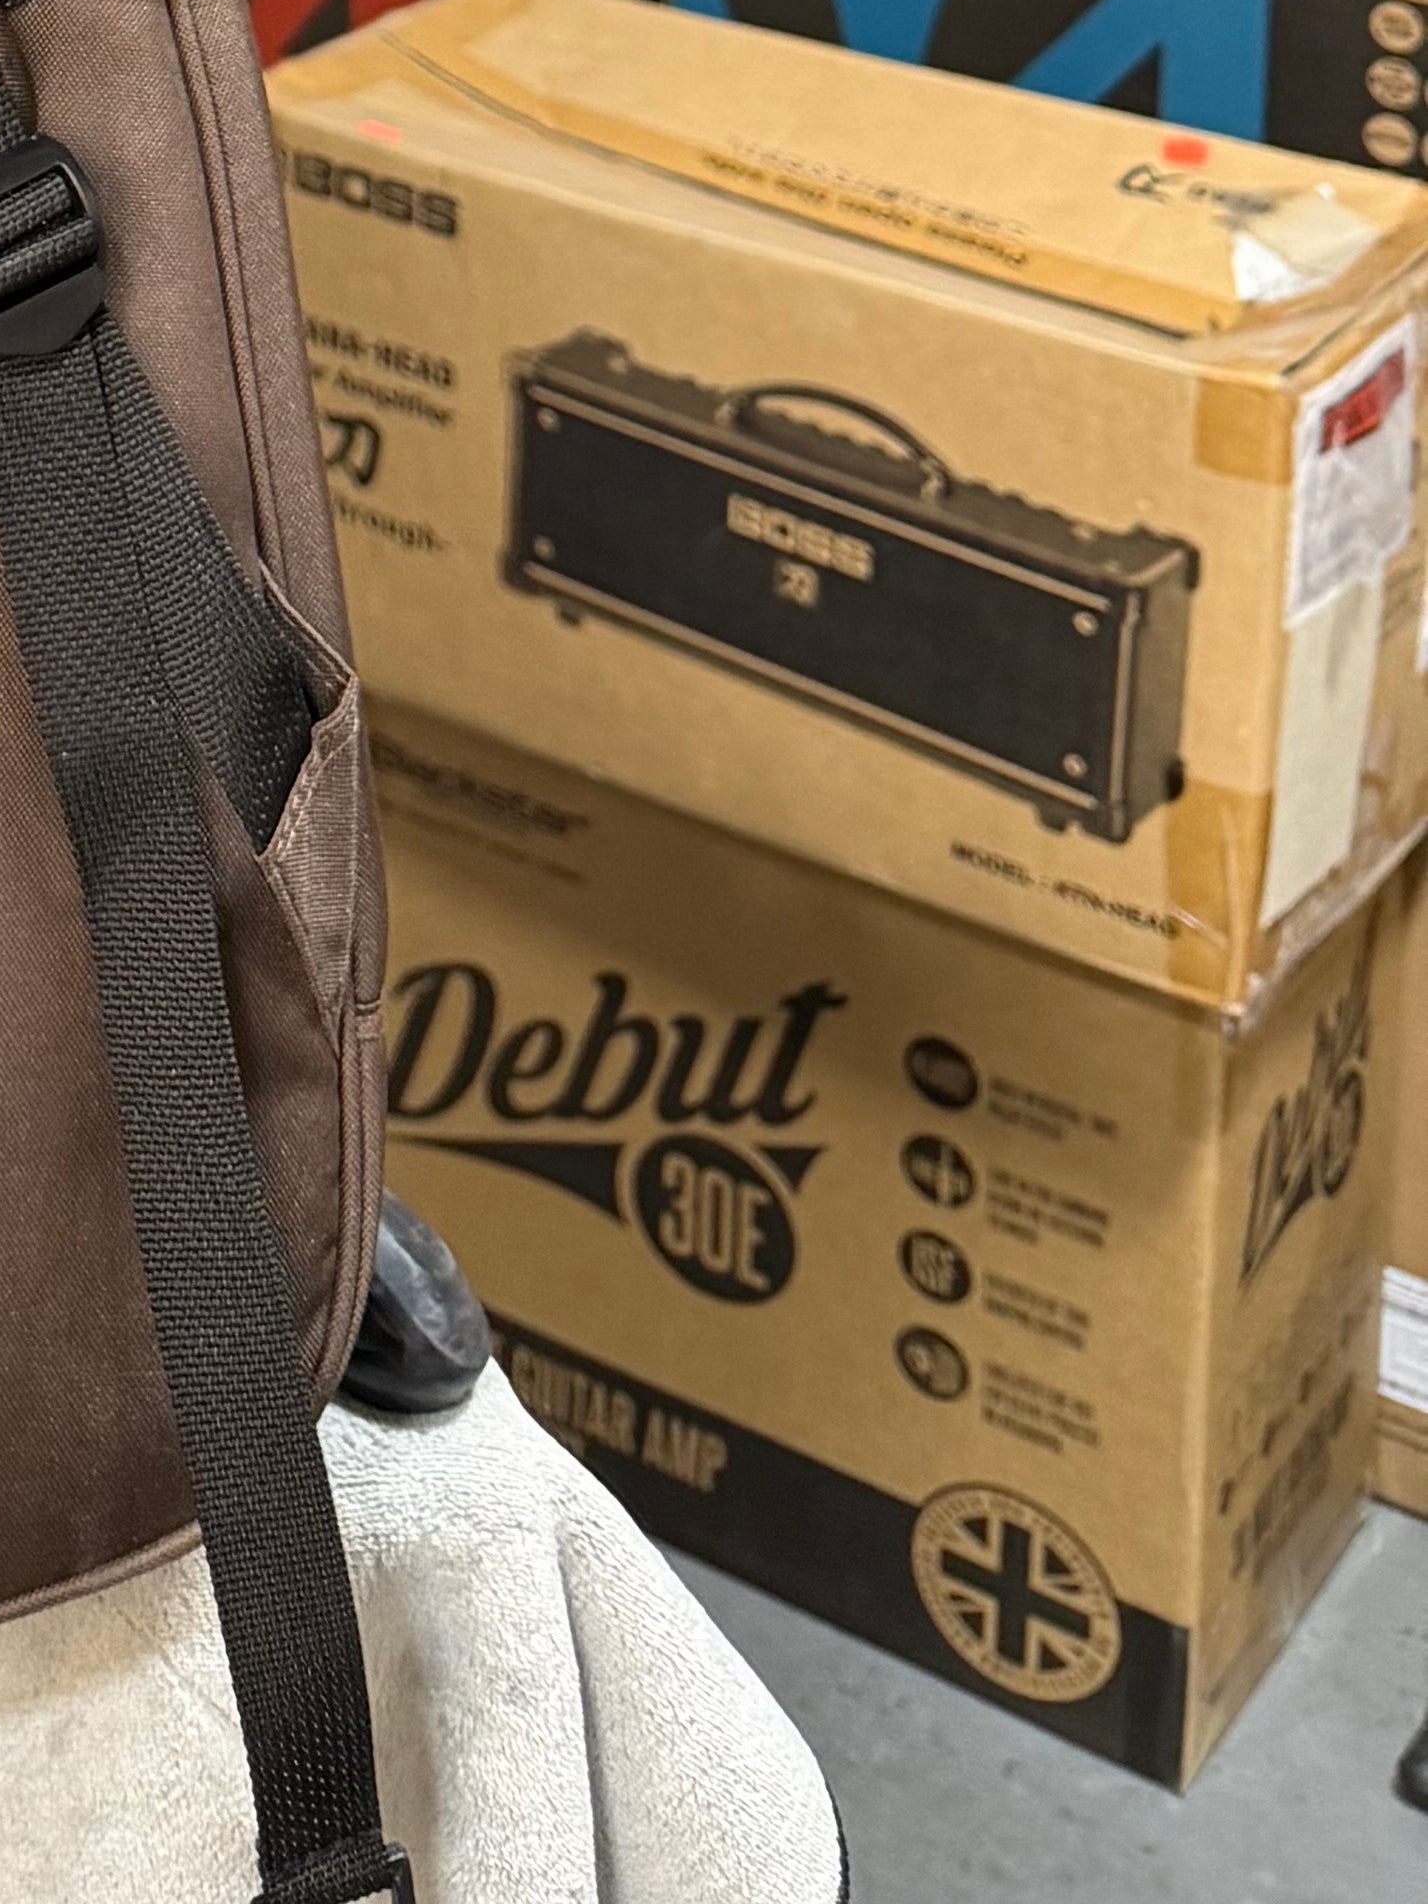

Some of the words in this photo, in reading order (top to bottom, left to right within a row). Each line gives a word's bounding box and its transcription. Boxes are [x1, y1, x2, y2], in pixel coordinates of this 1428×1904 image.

[294, 150, 463, 240] BOSS
[305, 315, 455, 390] ANA-HEAD
[727, 493, 876, 583] BOSS
[388, 962, 849, 1128] Debut
[660, 1150, 770, 1292] 30E
[511, 1343, 637, 1462] GUITAR
[642, 1406, 729, 1495] AMP
